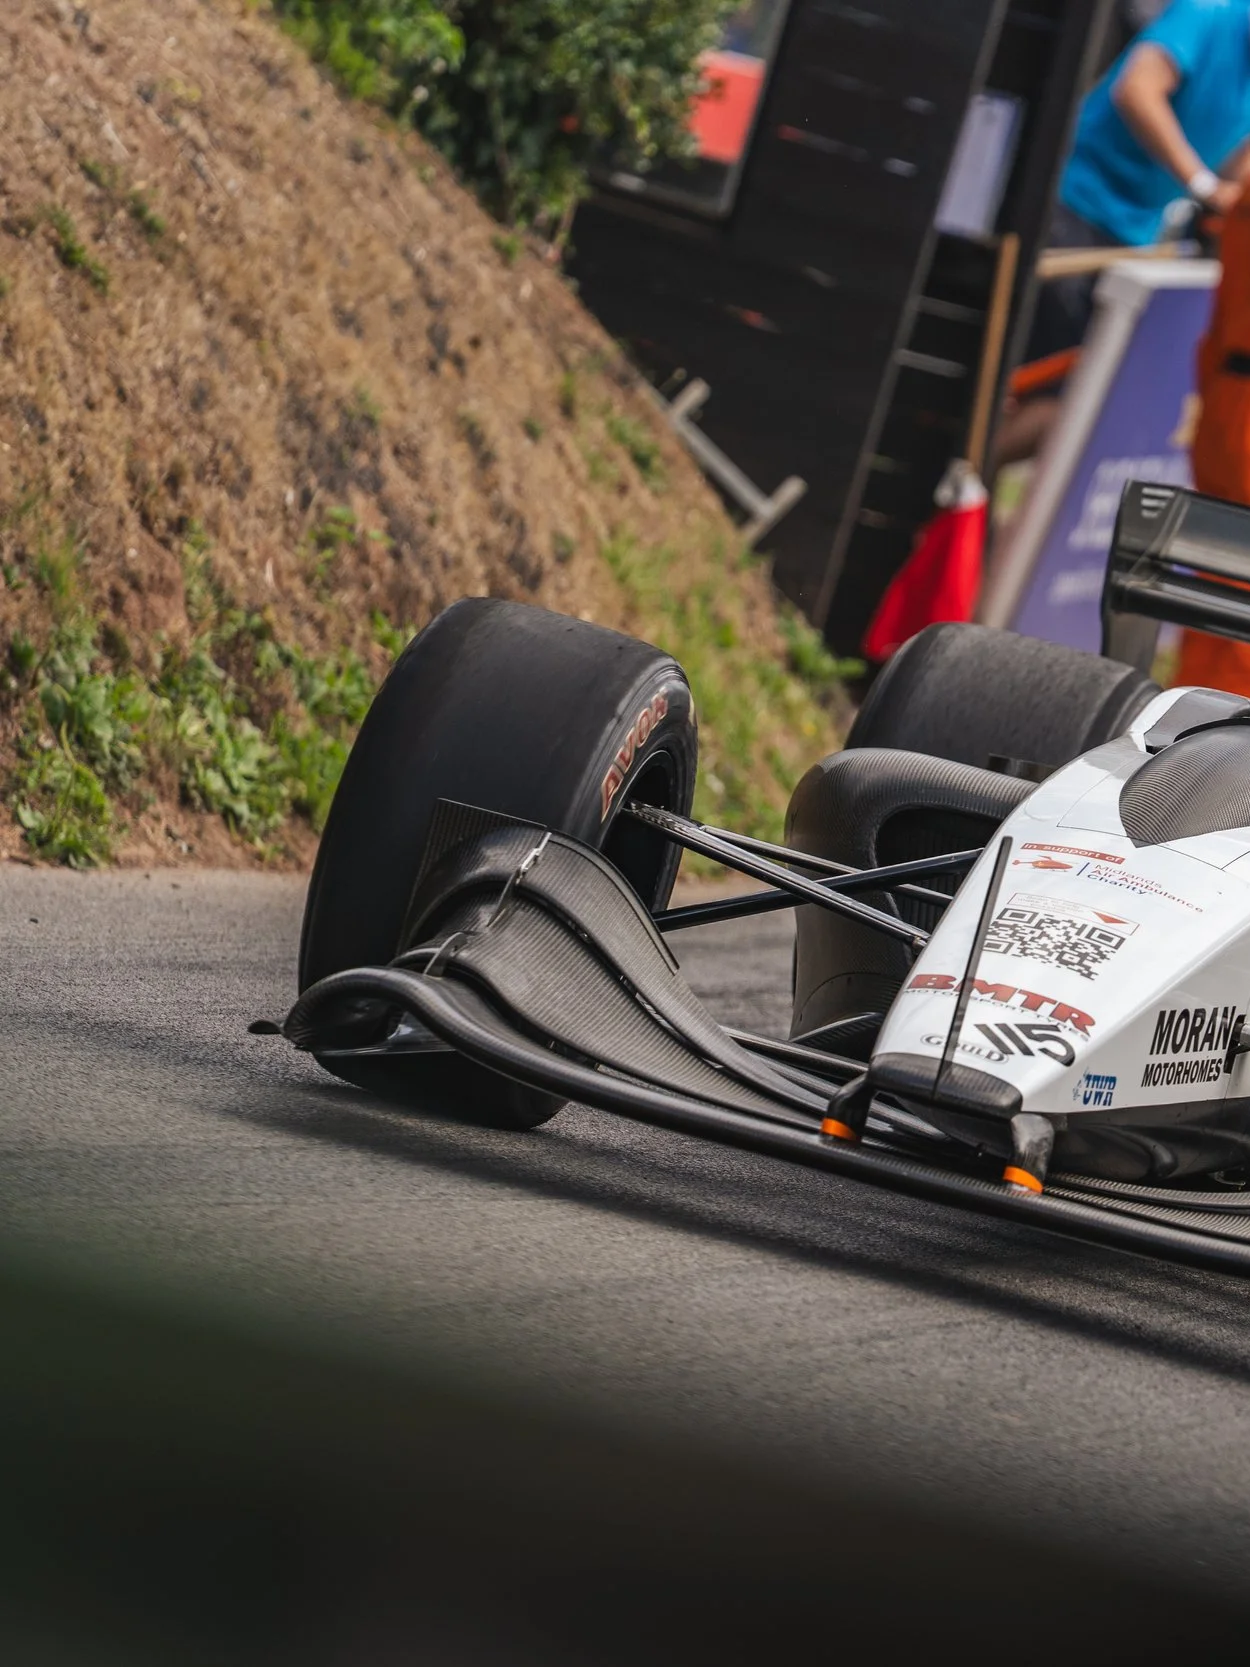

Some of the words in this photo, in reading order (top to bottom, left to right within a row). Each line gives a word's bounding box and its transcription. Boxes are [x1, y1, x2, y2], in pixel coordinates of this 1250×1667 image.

[1045, 845, 1100, 859] support
[1105, 856, 1122, 864] of
[1087, 874, 1146, 895] Charity
[1094, 864, 1163, 889] Midlands
[1090, 870, 1115, 879] Air
[1118, 876, 1204, 913] Ambulance
[907, 974, 1096, 1037] BMTR
[1149, 1006, 1237, 1056] MORAN
[924, 1035, 1006, 1063] GULD
[1141, 1058, 1223, 1088] MOTORHOMES
